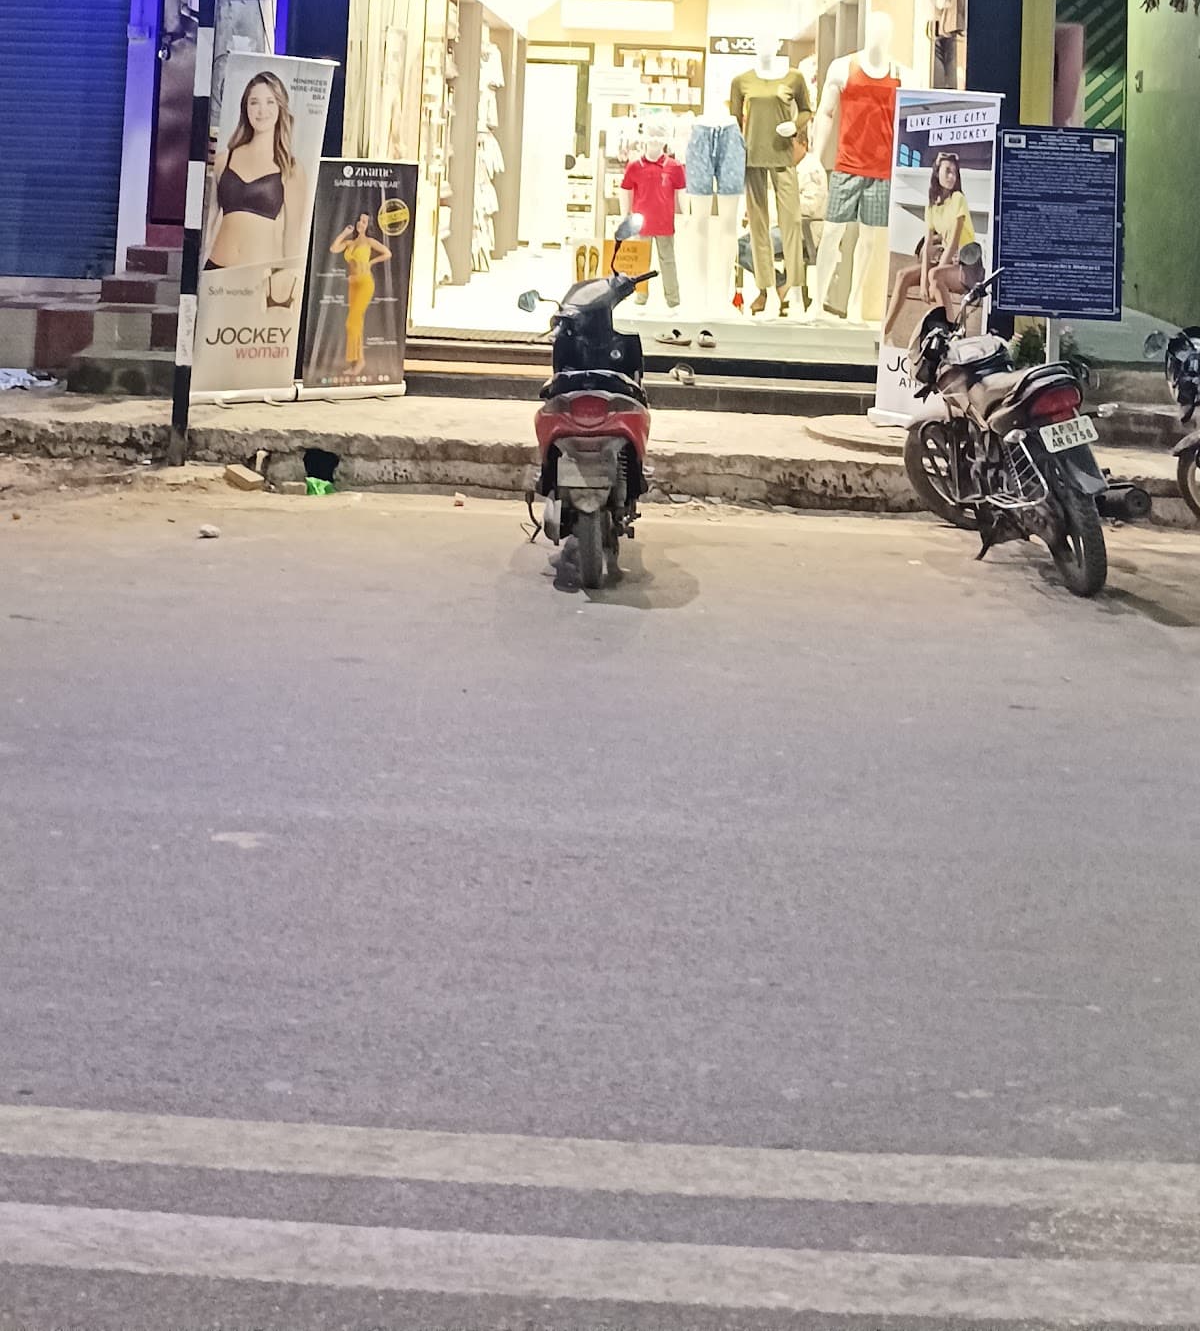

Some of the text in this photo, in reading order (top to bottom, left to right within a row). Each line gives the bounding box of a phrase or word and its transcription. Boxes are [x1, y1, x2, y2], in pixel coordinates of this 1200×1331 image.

[909, 111, 987, 128] LIVE THE CITY
[932, 128, 988, 142] IN JOCKEY
[205, 326, 292, 346] JOCKEY
[235, 346, 289, 359] woman
